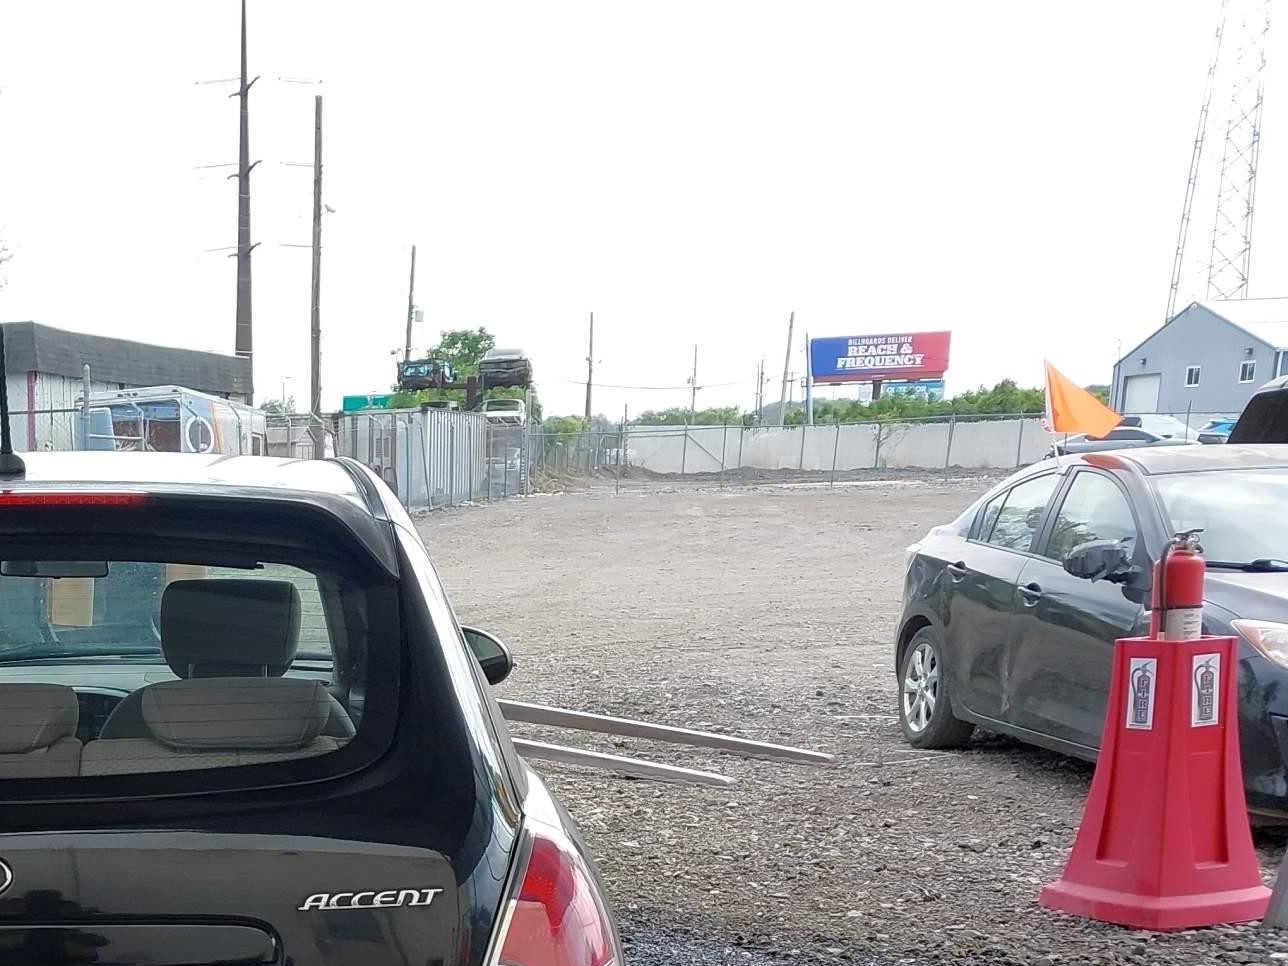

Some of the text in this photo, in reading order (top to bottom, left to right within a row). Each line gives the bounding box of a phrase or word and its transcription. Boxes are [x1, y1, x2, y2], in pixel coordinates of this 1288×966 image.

[847, 343, 914, 357] REACH &
[836, 353, 925, 369] FREQUENCY
[296, 887, 444, 912] ACCENT
